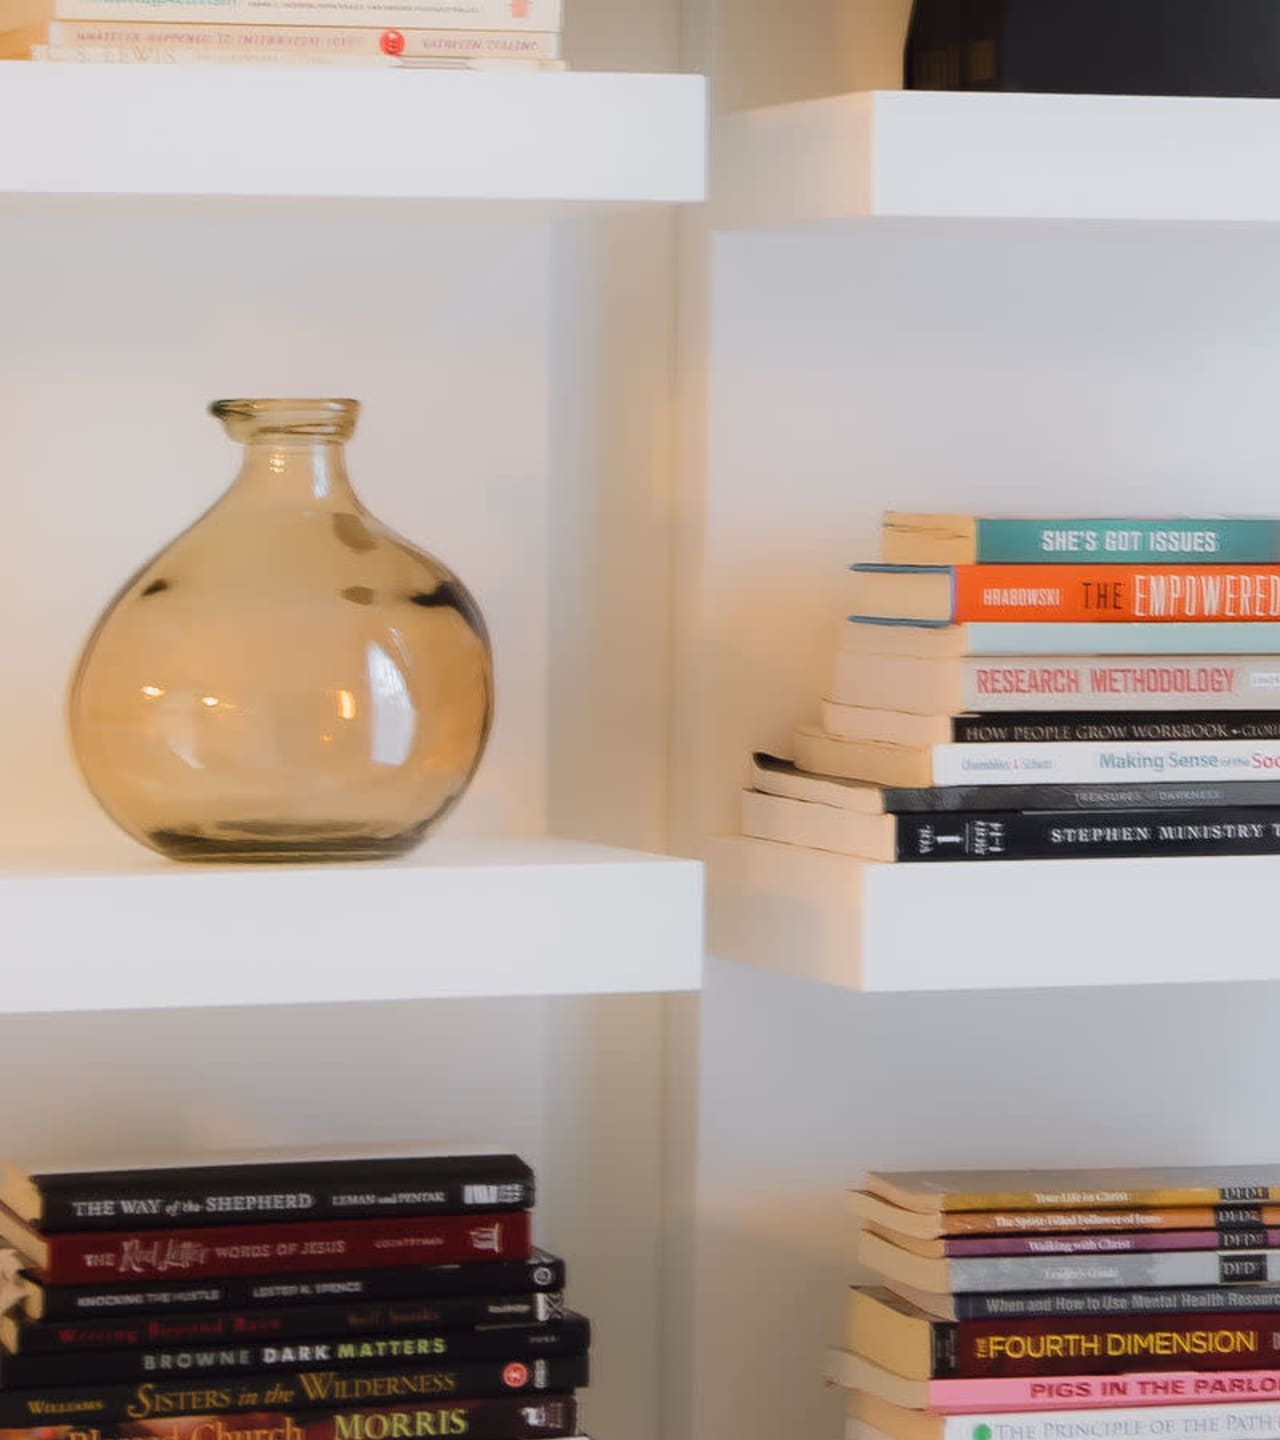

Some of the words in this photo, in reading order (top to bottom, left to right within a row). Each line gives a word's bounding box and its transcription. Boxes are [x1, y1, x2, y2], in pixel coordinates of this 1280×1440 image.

[1041, 530, 1098, 552] SHE'S
[1104, 531, 1142, 552] GOT
[1149, 531, 1217, 553] ISSUES
[982, 587, 1061, 607] HRABOWSKI
[1082, 582, 1126, 610] THE
[976, 668, 1080, 694] RESEARCH
[1090, 668, 1236, 694] METHODOLOGY
[965, 727, 1008, 741] HOW
[1013, 726, 1071, 741] PEOPLE
[1075, 726, 1128, 740] GROW
[1132, 724, 1228, 739] WORKBOOK
[1049, 825, 1150, 845] STEPHEN
[1158, 823, 1264, 841] MINISTRY
[72, 1201, 115, 1217] THE
[120, 1199, 164, 1215] WAY
[165, 1200, 180, 1218] of
[182, 1200, 201, 1213] the
[205, 1194, 314, 1212] SHEPHERD
[986, 1298, 1024, 1312] When
[1026, 1297, 1051, 1311] and
[1055, 1297, 1085, 1311] How
[1087, 1297, 1100, 1310] to
[1102, 1296, 1128, 1310] Use
[1131, 1294, 1178, 1309] Mental
[1181, 1292, 1224, 1308] Health
[263, 1344, 330, 1364] DARK
[337, 1338, 448, 1359] MATTERS
[989, 1333, 1100, 1359] FOURTH
[1107, 1330, 1258, 1357] DIMENSION
[144, 1350, 250, 1370] BROWNE
[1030, 1382, 1091, 1399] PIGS
[1101, 1381, 1128, 1397] IN
[1138, 1380, 1185, 1395] THE
